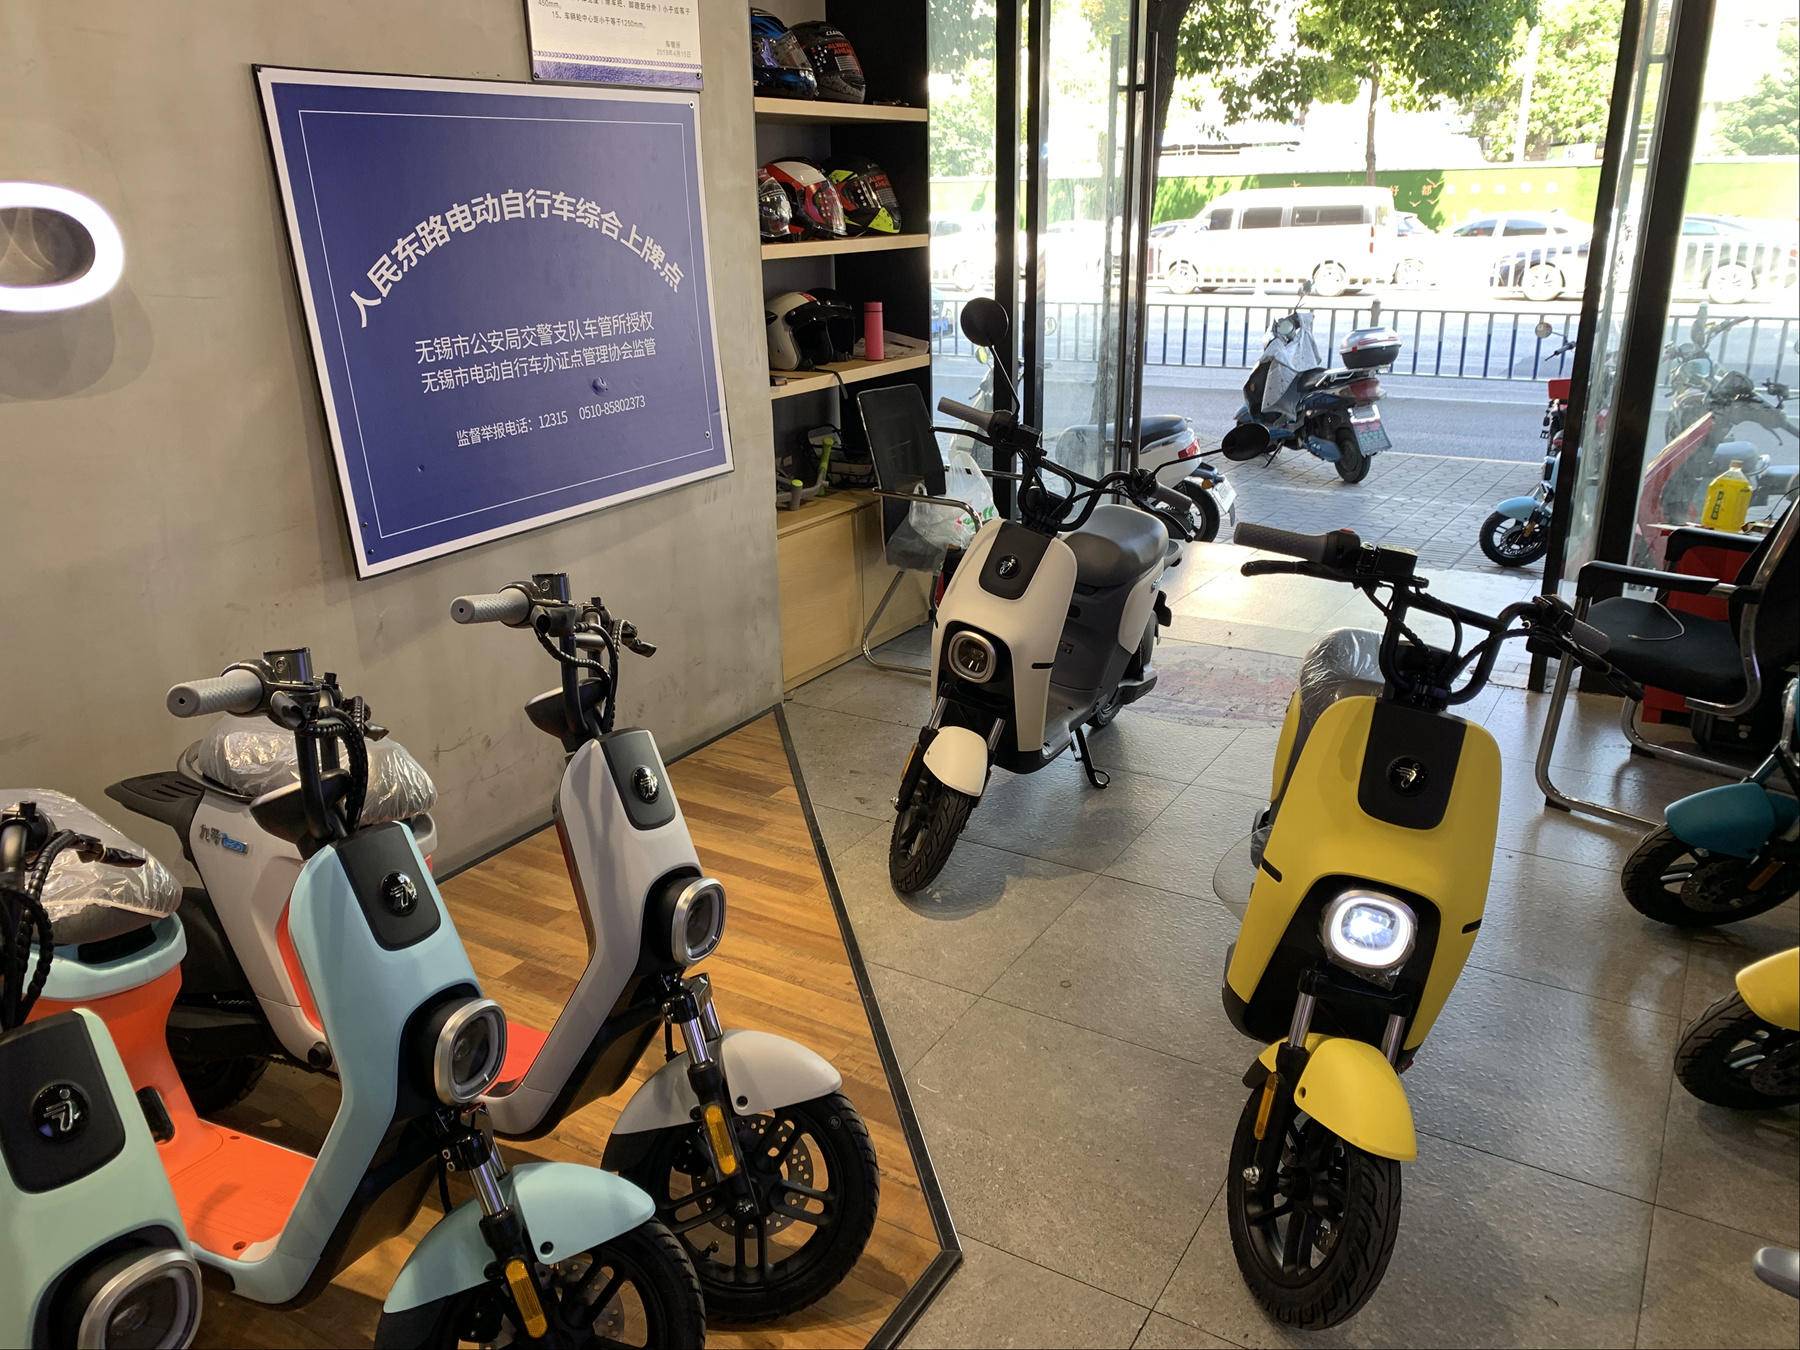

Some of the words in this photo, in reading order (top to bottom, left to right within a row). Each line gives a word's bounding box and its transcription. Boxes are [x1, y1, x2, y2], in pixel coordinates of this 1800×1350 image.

[349, 188, 685, 328] 人民东路电动自行车综合上牌点
[414, 310, 655, 365] 无锡市公安局交警支队车管所授权
[420, 336, 657, 394] 无锡市电动自行车办证点管理协会监管
[455, 416, 533, 448] 监督举报电话：
[538, 410, 569, 430] 12315
[578, 394, 647, 421] 0510-85802373
